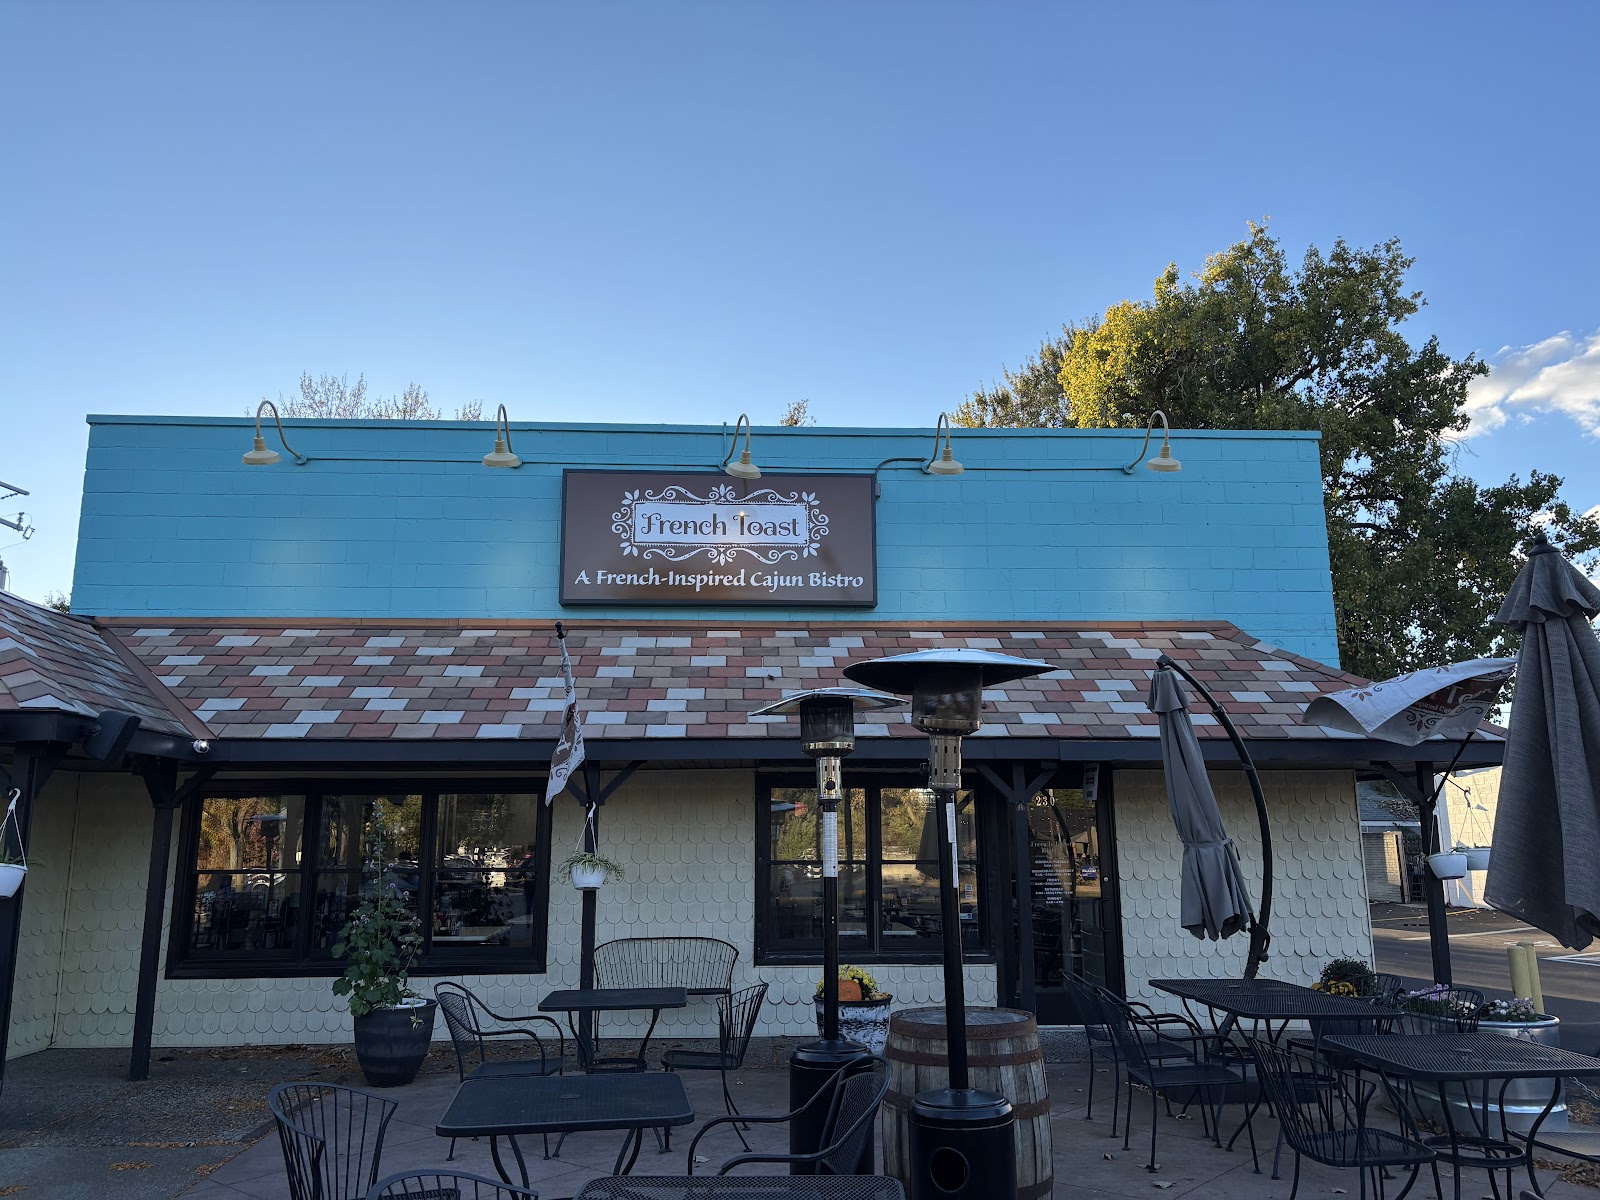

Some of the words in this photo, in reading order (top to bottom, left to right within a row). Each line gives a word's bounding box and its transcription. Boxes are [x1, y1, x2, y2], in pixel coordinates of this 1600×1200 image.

[641, 512, 727, 536] French
[732, 513, 801, 537] Toast
[574, 570, 591, 585] A
[596, 567, 746, 592] French-Inspired
[750, 571, 804, 593] Cajun
[808, 571, 864, 588] Bistro
[1035, 795, 1055, 807] 230
